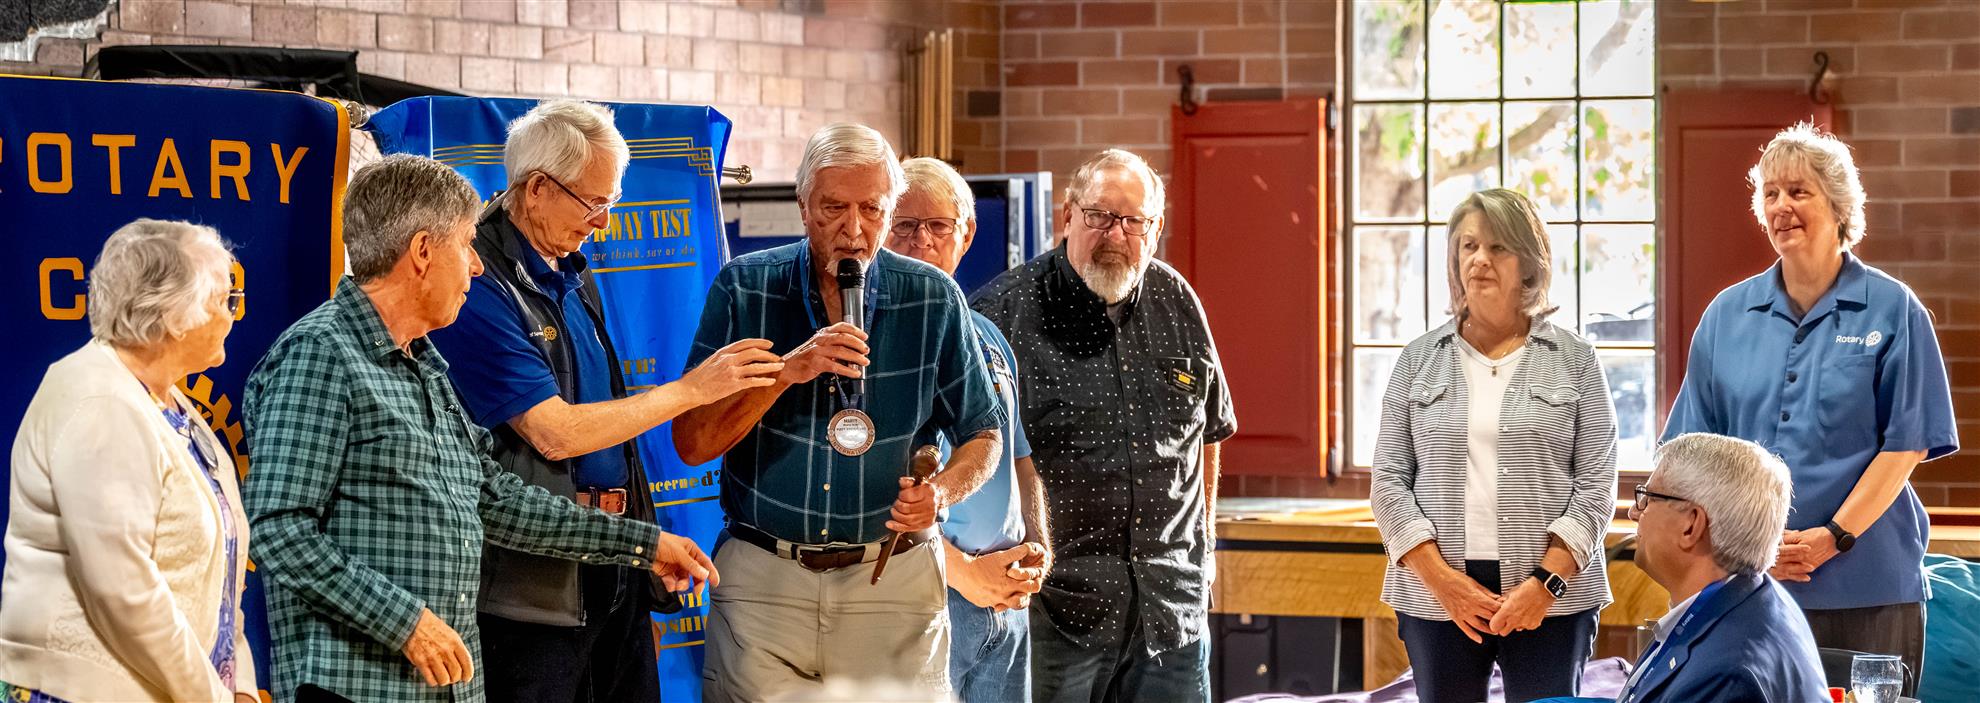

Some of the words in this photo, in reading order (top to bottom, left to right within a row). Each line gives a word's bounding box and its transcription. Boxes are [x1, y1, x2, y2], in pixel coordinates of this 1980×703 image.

[0, 132, 309, 204] OTARY
[650, 208, 692, 238] TEST
[592, 253, 606, 261] we
[1835, 335, 1865, 345] Rotary
[649, 469, 720, 493] ncerned?
